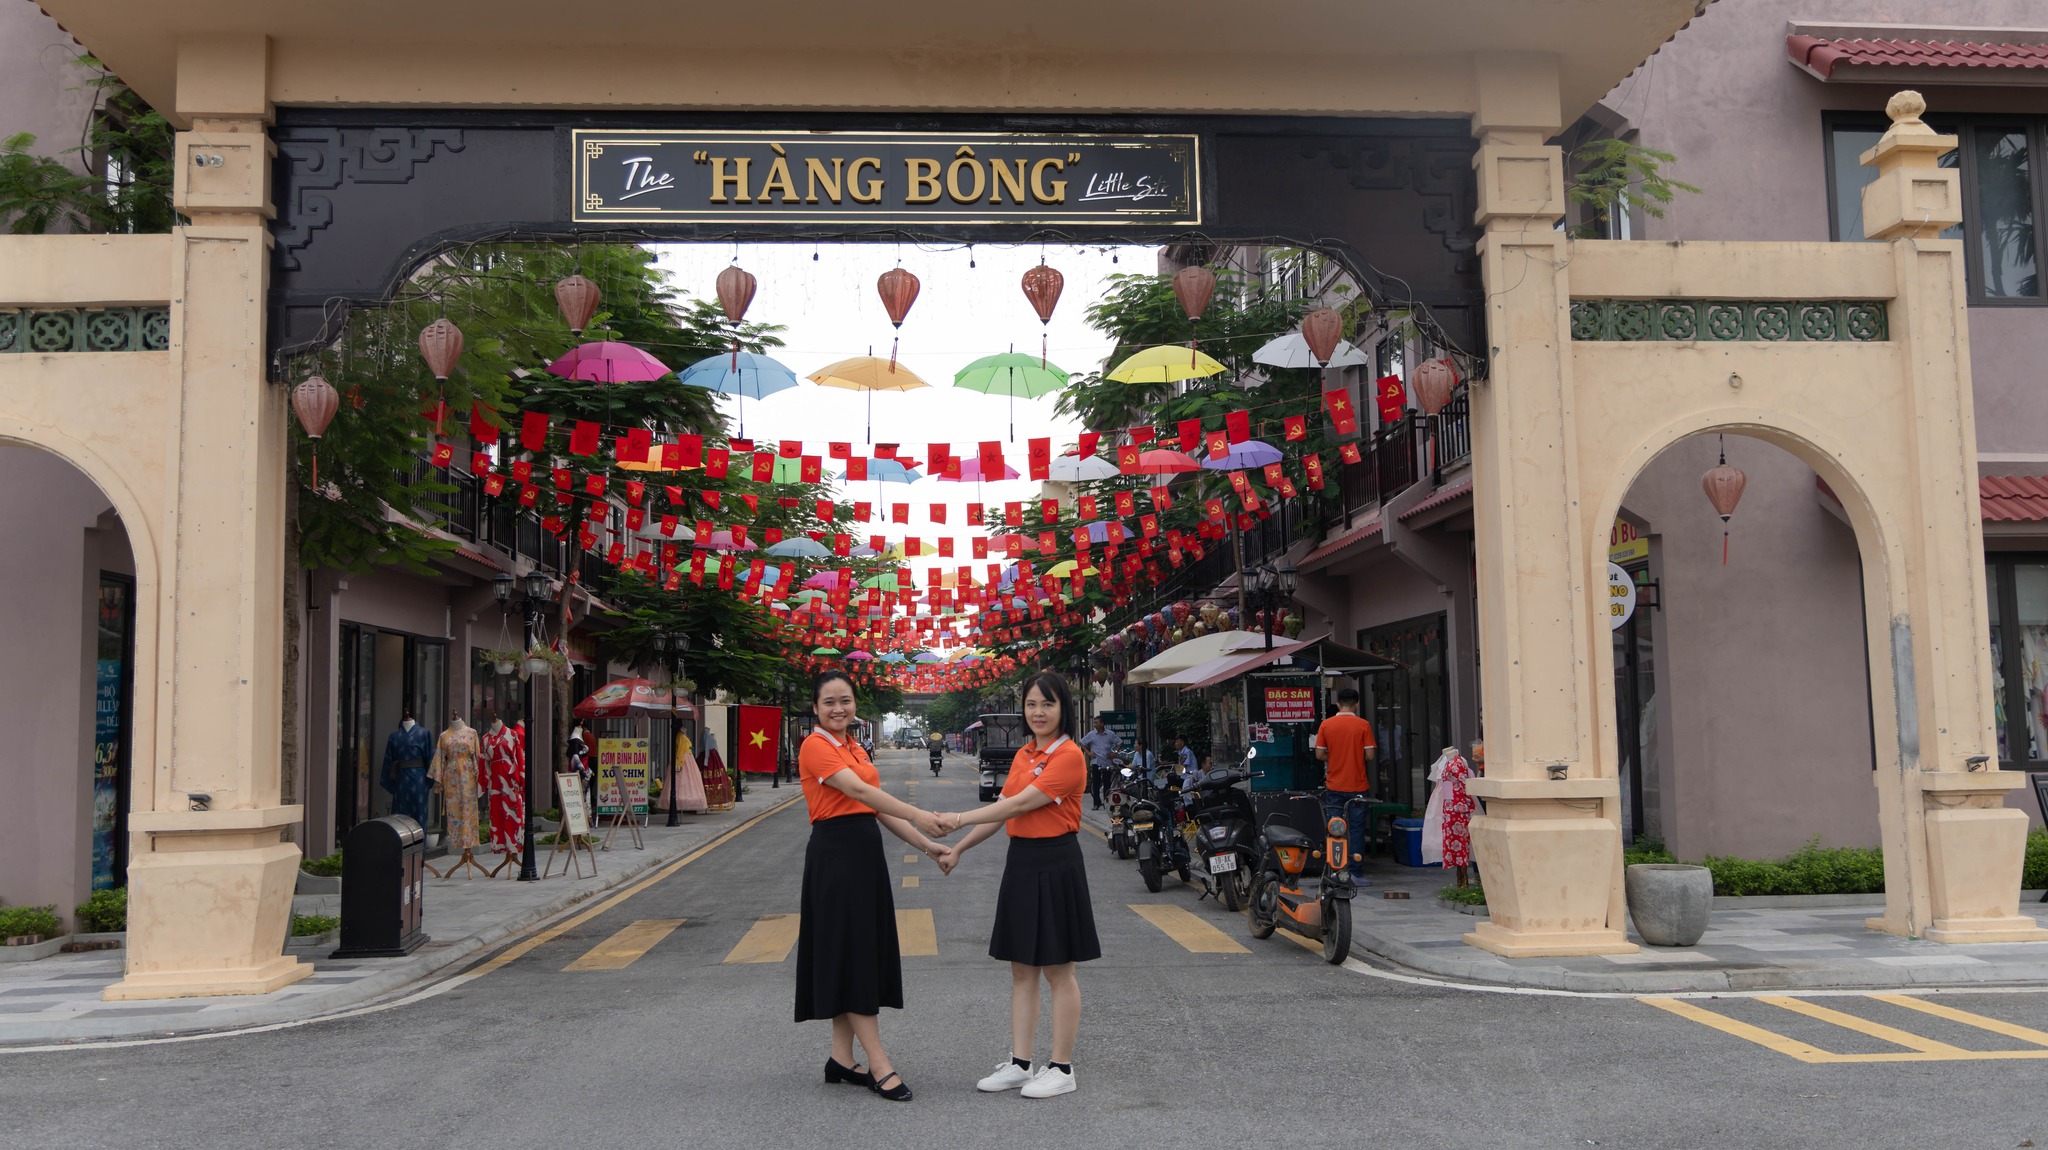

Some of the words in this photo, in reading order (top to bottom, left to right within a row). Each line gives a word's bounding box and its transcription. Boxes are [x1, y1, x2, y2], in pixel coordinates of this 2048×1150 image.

[621, 156, 675, 193] The
[1085, 171, 1132, 198] Little
[1268, 690, 1288, 700] ĐẶC
[1290, 689, 1311, 699] SẢN
[601, 751, 615, 765] CƠM
[617, 749, 632, 765] BÌNH
[633, 749, 647, 765] DÂN
[622, 768, 645, 778] CHIM
